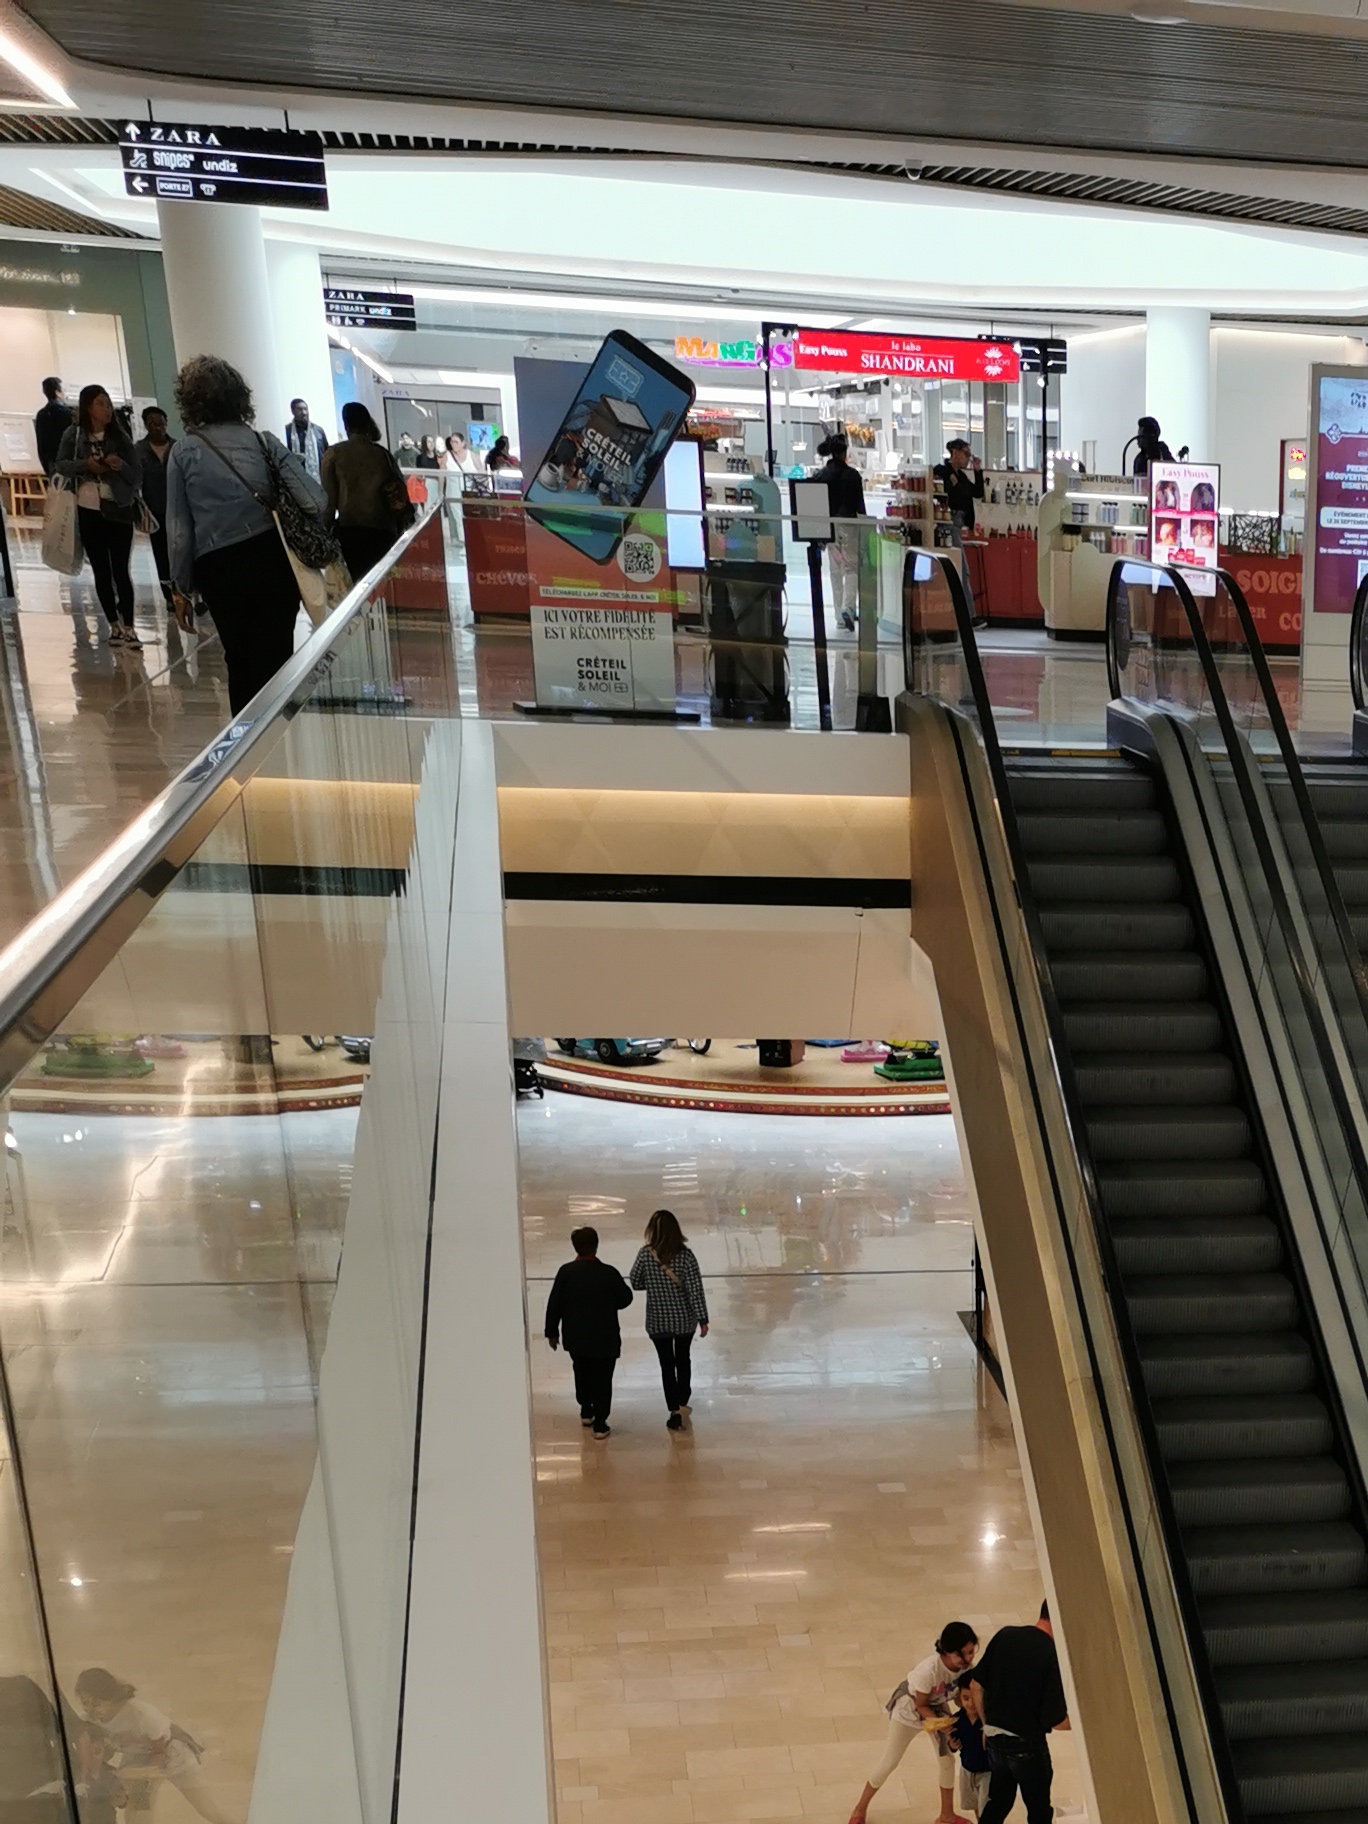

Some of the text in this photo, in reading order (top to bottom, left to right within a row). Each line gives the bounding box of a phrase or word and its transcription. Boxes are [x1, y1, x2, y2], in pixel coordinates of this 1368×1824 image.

[150, 127, 222, 147] ZARA
[202, 159, 239, 173] undiz
[328, 291, 365, 301] ZARA
[860, 353, 955, 375] SHANDRANI
[581, 437, 622, 471] SOLEIL
[586, 427, 632, 466] CRÉTEIL
[543, 608, 559, 623] ICI
[560, 609, 602, 624] VOTRE
[544, 624, 656, 641] EST RÉCOMPENSÉE
[577, 656, 627, 670] CRÉTEIL
[577, 670, 621, 681] SOLEIL
[577, 682, 612, 693] & MOI
